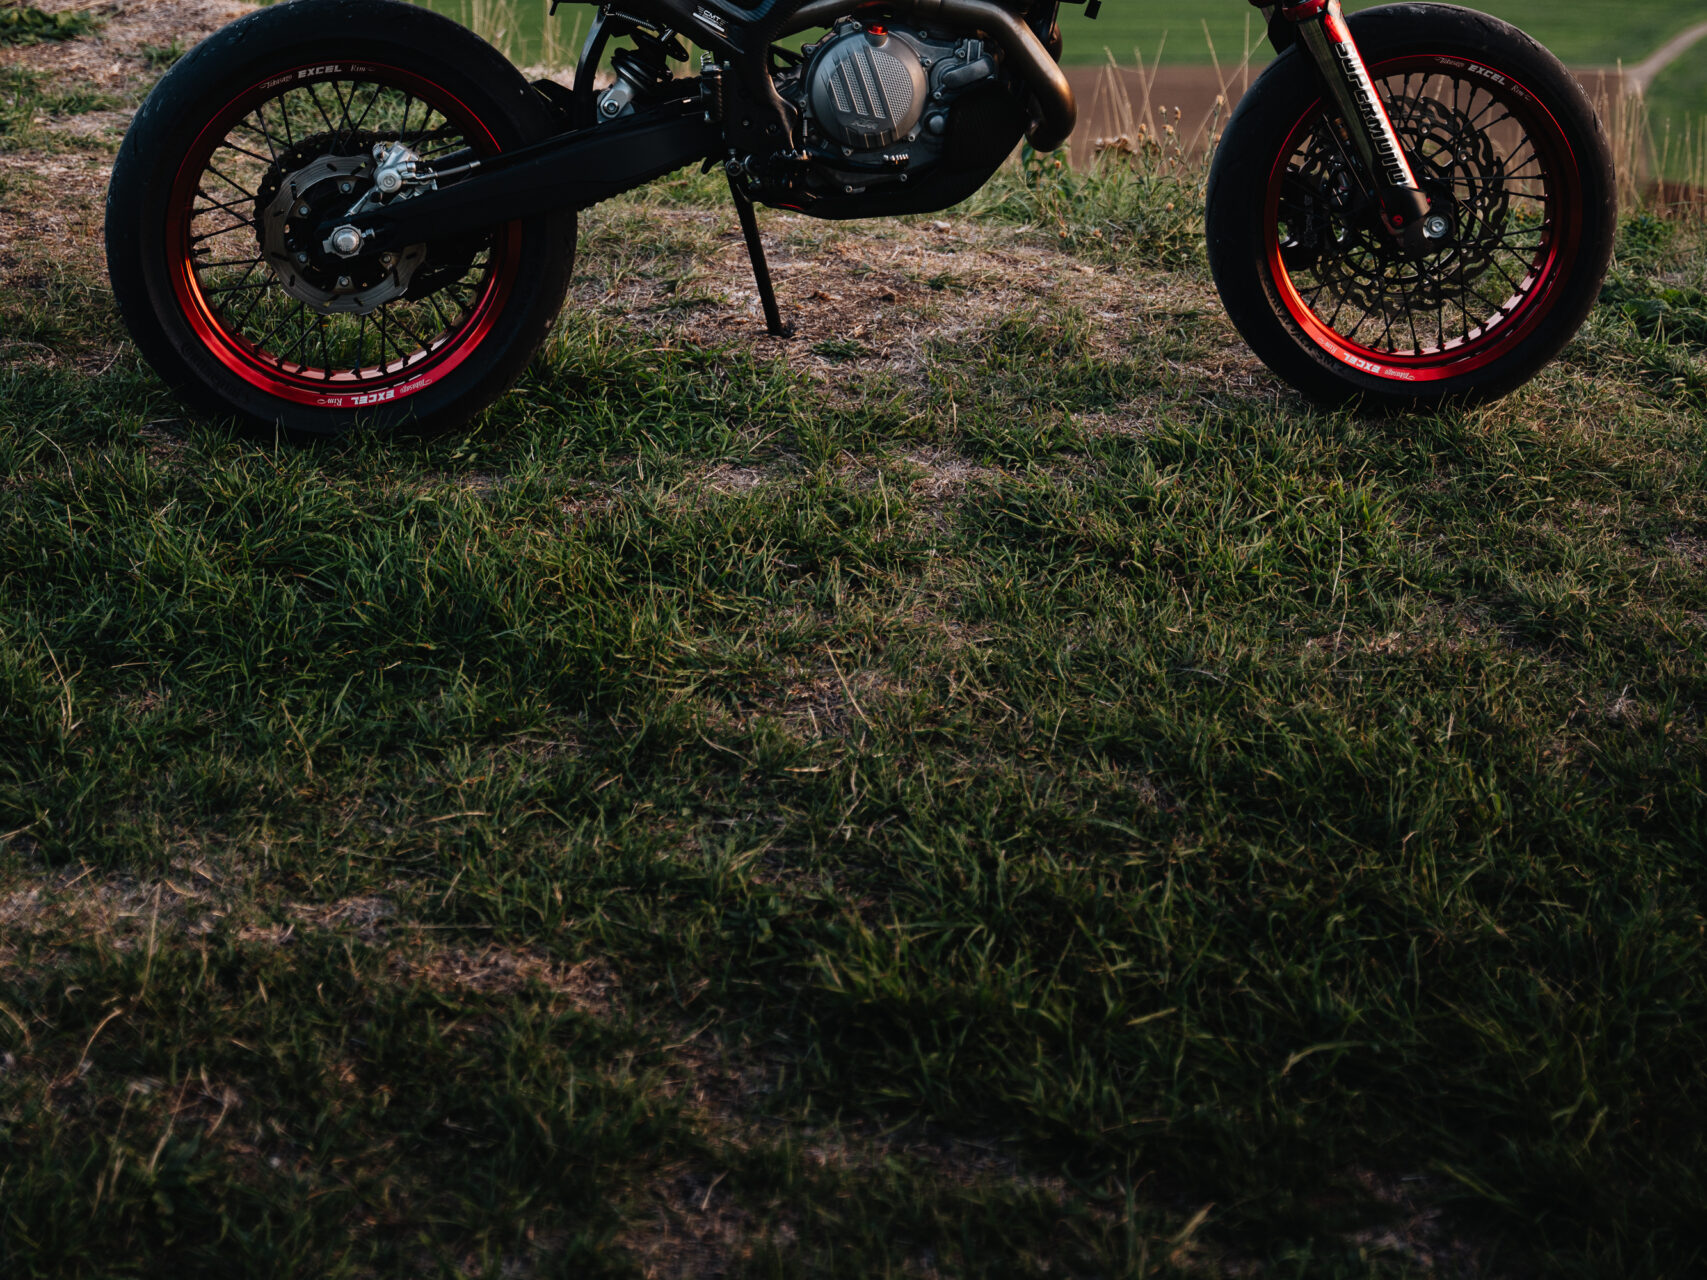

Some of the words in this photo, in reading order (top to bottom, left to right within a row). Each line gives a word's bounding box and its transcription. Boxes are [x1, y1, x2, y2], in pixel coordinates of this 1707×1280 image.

[297, 64, 342, 79] EXCEL
[350, 64, 367, 72] Rim
[1467, 63, 1506, 86] EXCEL
[1334, 40, 1410, 186] SUPERMOTO
[1343, 352, 1382, 374] EXCEL
[327, 397, 343, 407] Rim
[350, 389, 396, 406] EXCEL
